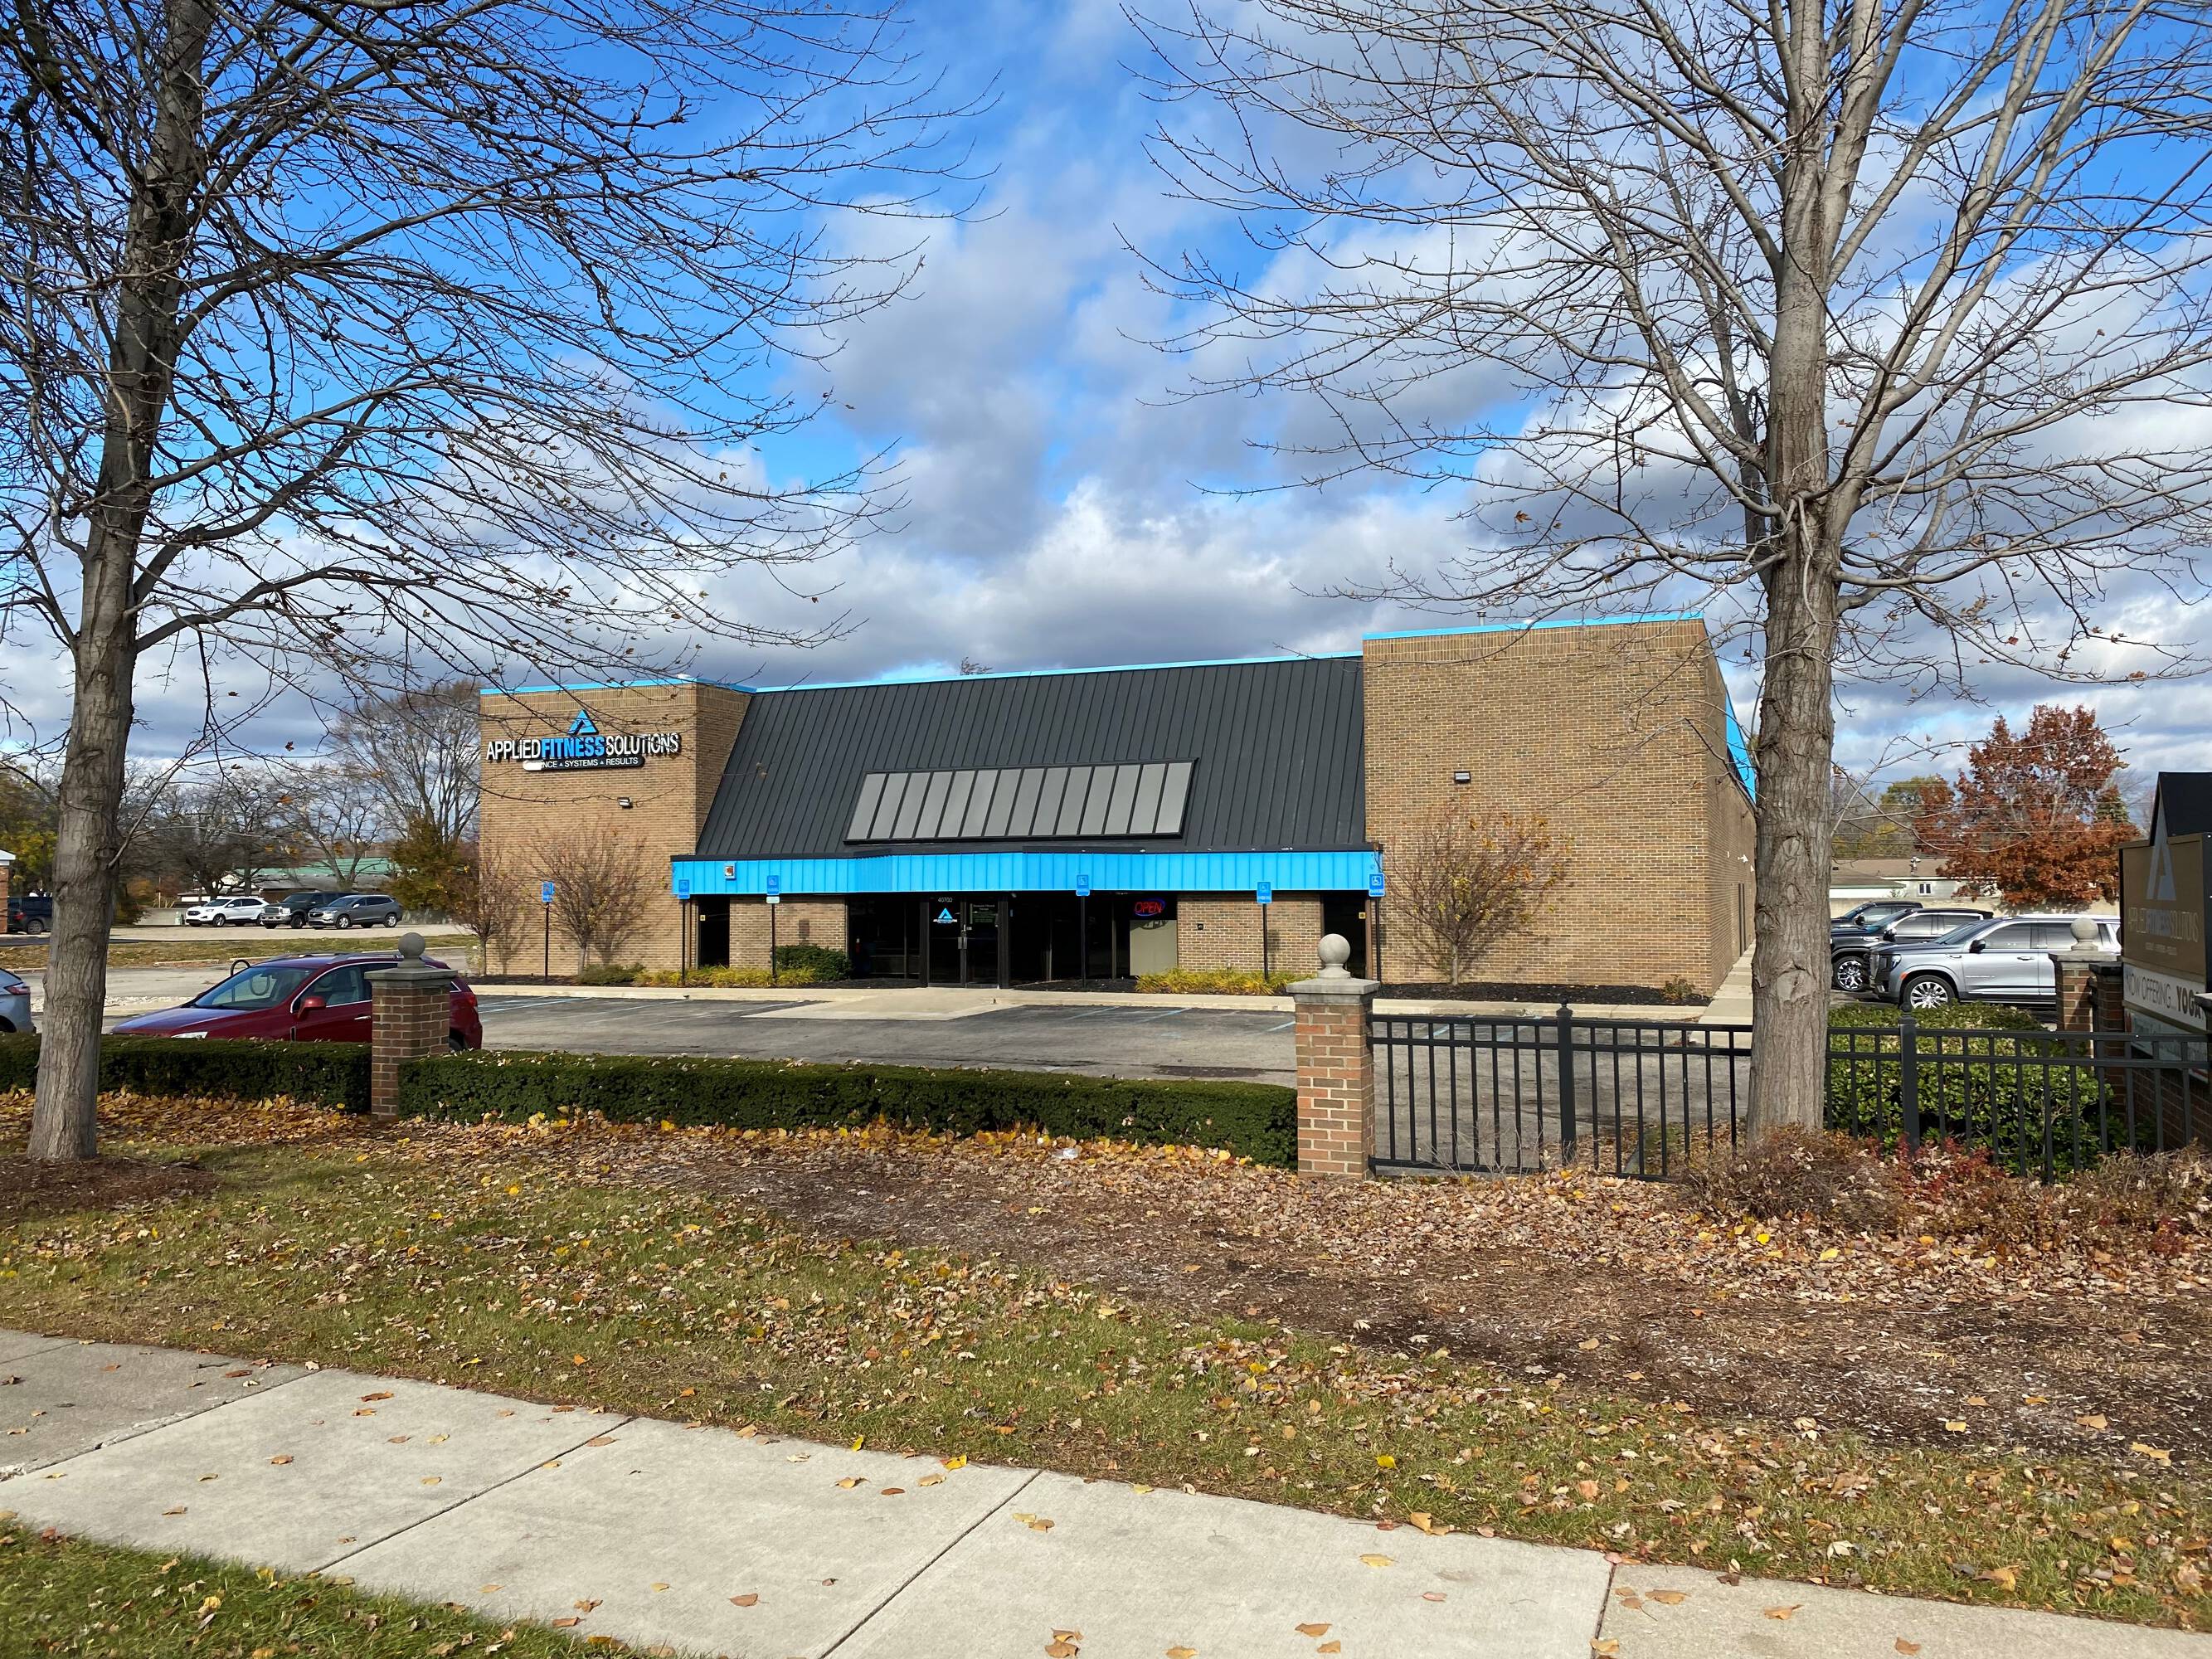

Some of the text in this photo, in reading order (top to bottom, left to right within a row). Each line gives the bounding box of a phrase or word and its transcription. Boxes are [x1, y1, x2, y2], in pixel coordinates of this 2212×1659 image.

[565, 759, 598, 768] SYSTEMS
[605, 757, 639, 766] RESULTS
[1135, 901, 1163, 913] OPEN
